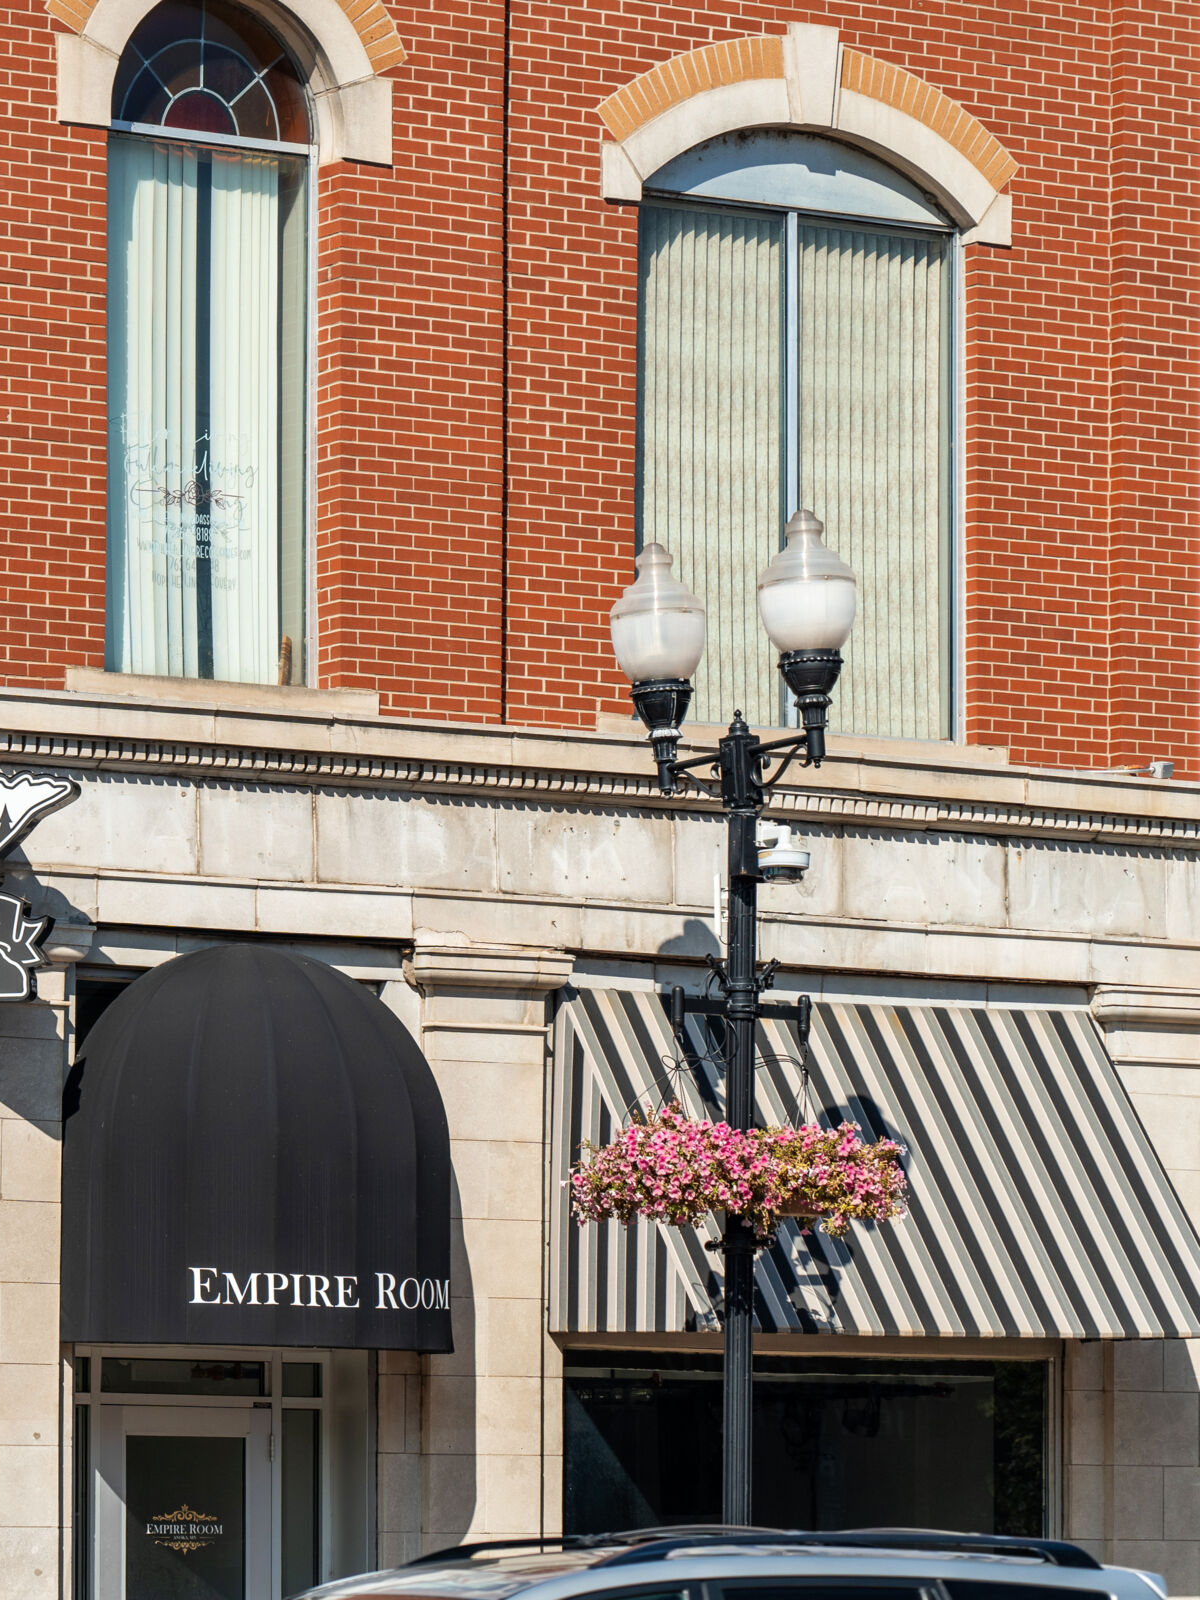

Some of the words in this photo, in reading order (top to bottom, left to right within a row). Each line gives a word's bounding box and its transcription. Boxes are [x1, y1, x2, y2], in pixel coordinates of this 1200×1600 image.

[188, 1266, 360, 1309] EMPIRE
[374, 1272, 451, 1310] ROOM
[146, 1523, 187, 1534] EMPIRE
[189, 1523, 223, 1534] ROOM
